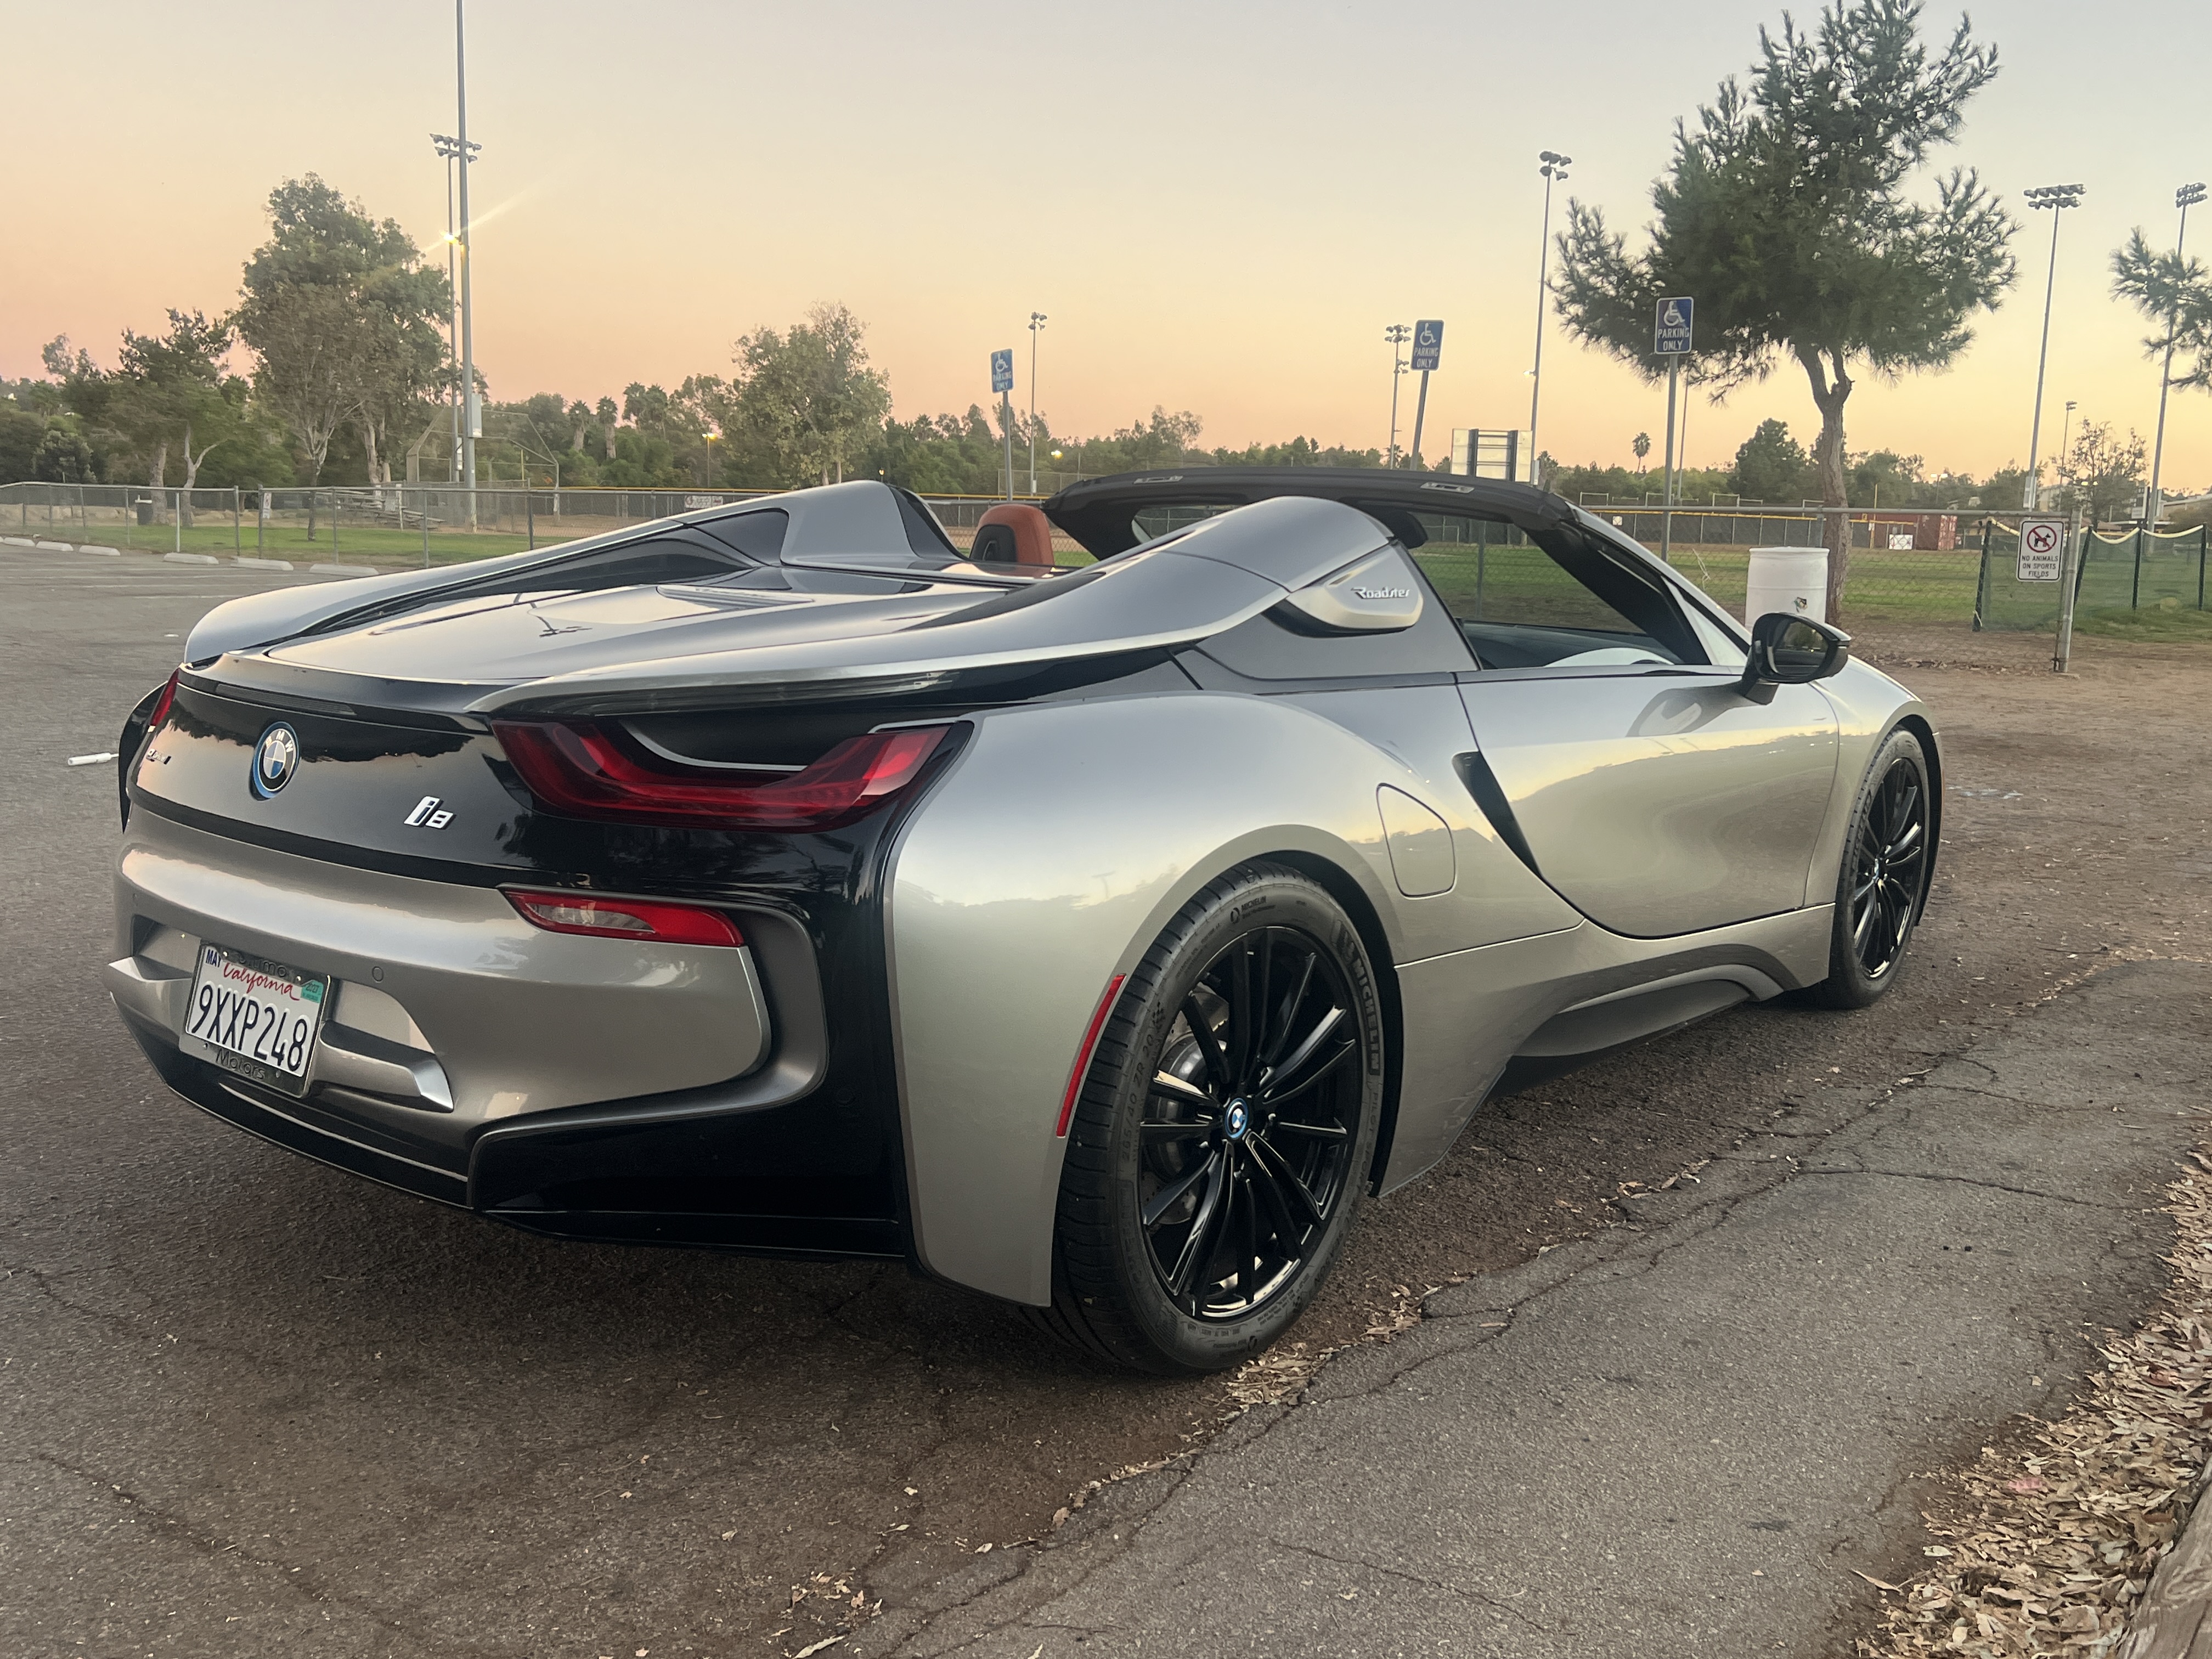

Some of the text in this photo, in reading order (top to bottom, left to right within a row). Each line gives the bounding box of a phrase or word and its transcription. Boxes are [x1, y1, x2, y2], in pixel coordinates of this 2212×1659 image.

[1657, 328, 1690, 338] PARKING
[1414, 347, 1439, 357] PARKING
[1663, 340, 1683, 351] ONLY
[1417, 358, 1433, 368] ONLY
[1351, 586, 1410, 599] Roadster
[266, 730, 294, 753] BMW
[223, 962, 300, 1001] California
[1352, 958, 1380, 1070] MICHELIN
[191, 984, 308, 1071] 9XXP248
[216, 1048, 265, 1080] Motors
